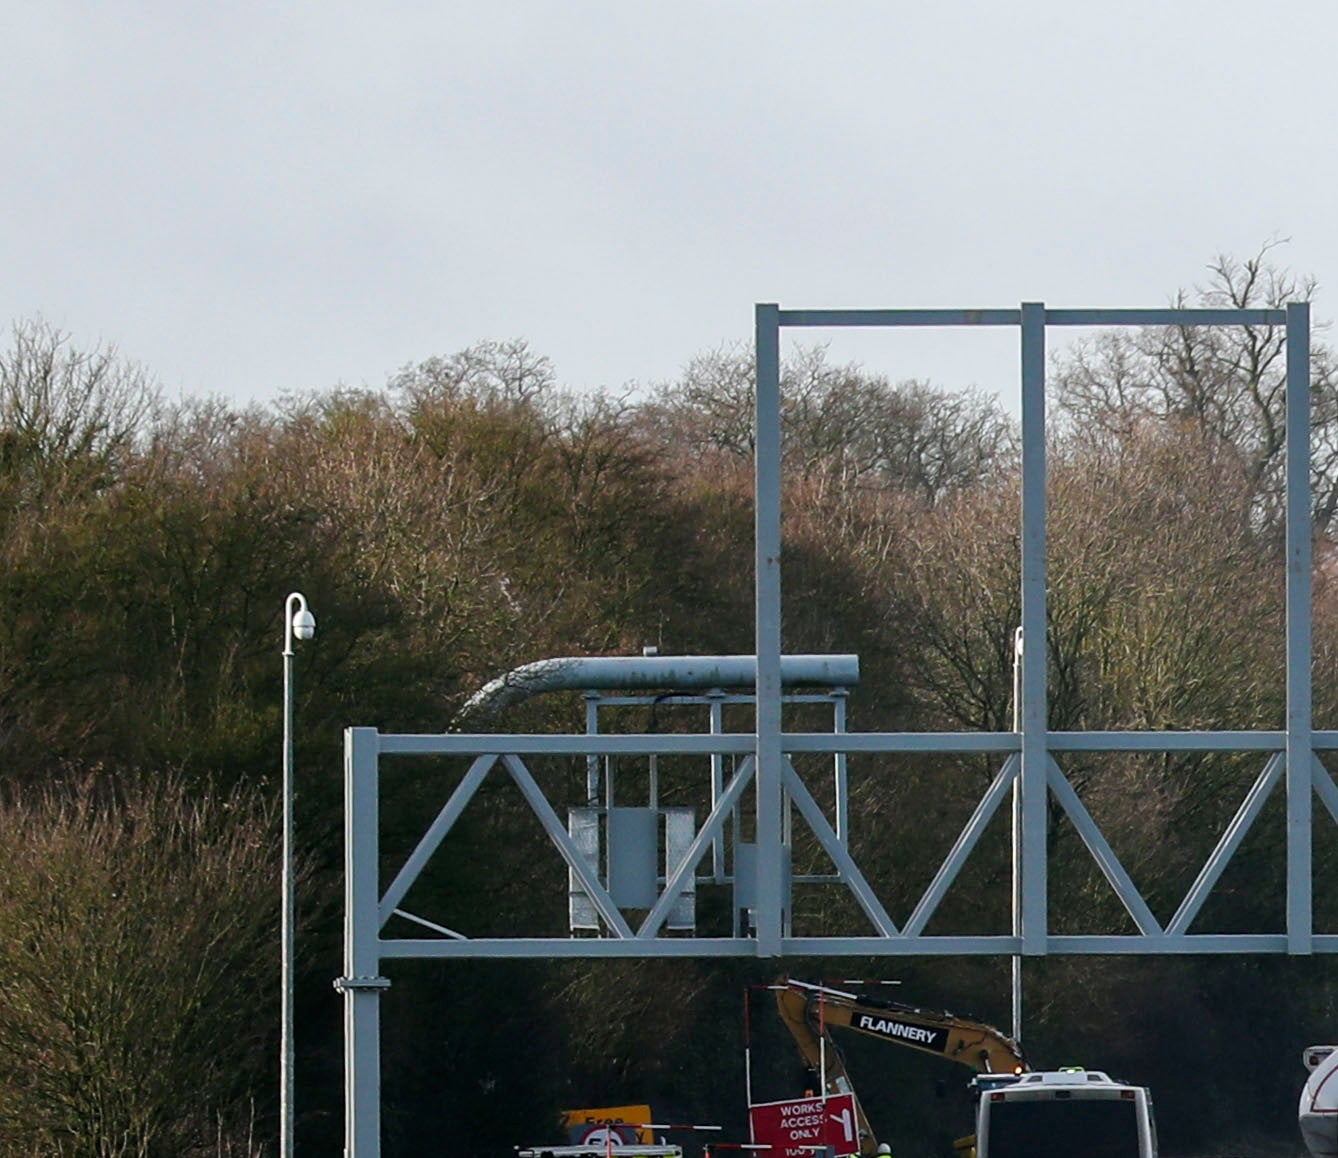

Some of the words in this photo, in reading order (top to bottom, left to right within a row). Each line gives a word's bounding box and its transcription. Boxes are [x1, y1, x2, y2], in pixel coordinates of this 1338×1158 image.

[860, 1016, 936, 1043] FLANNERY
[780, 1102, 824, 1117] WORKS
[789, 1127, 820, 1140] ONLY
